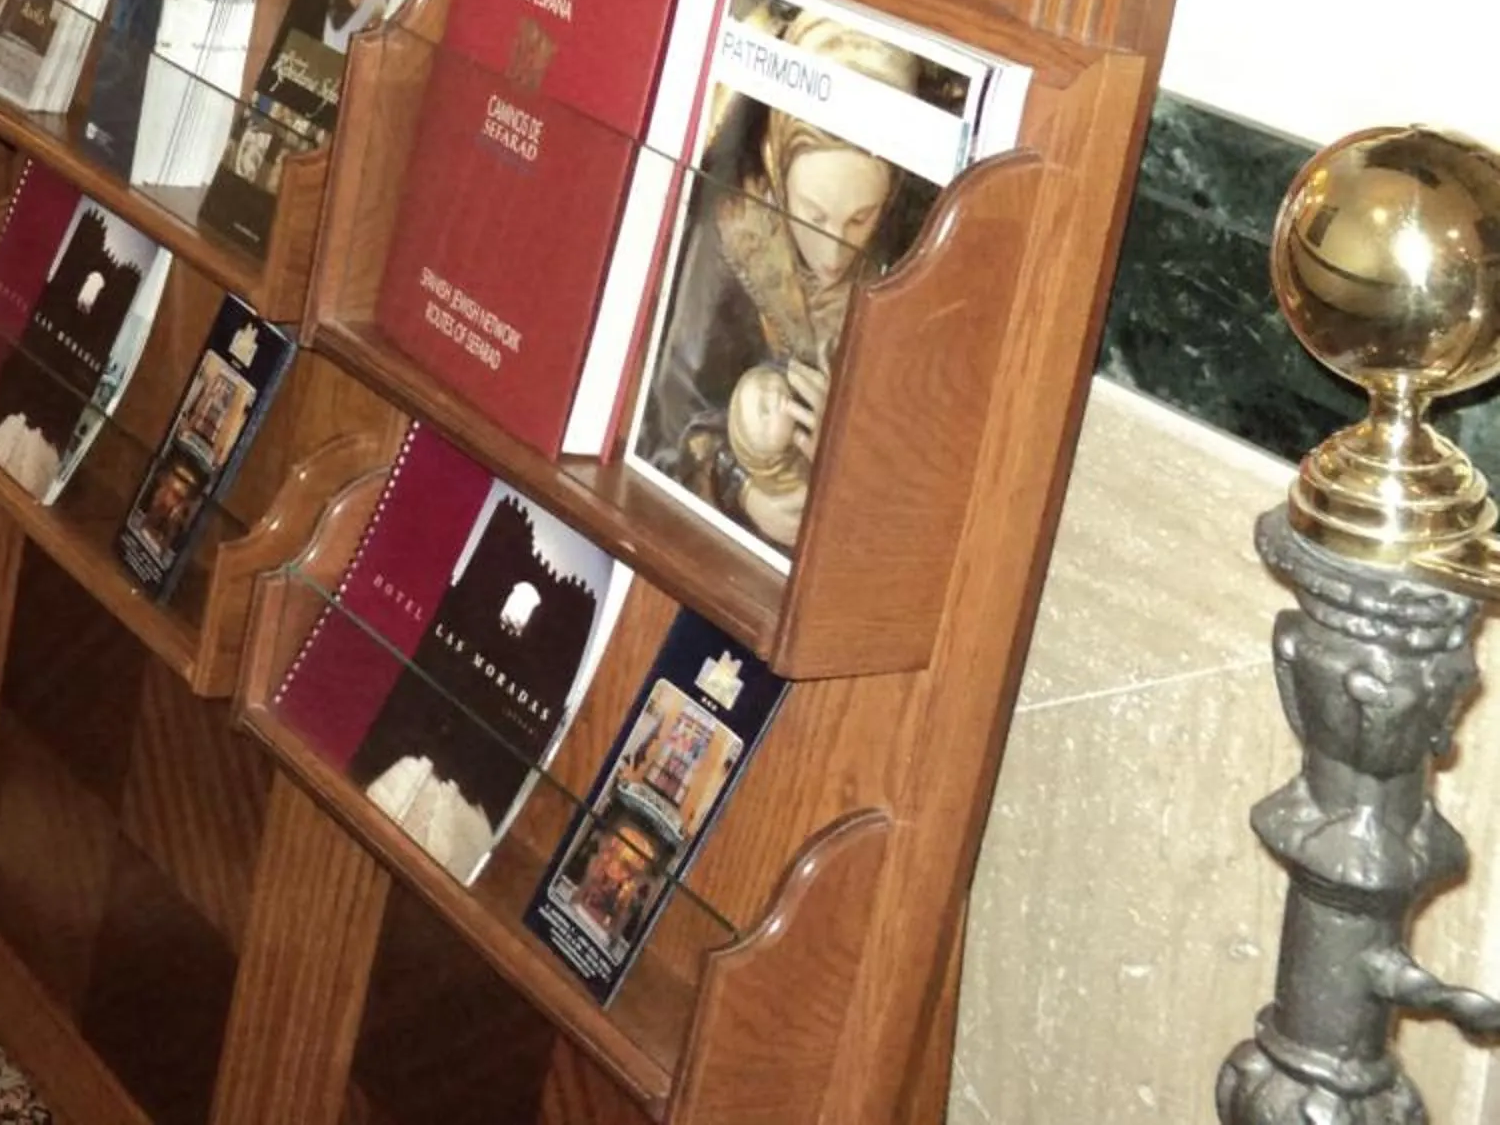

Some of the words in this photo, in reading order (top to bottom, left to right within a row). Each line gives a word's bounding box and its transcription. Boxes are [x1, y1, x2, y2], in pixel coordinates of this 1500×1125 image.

[721, 30, 833, 103] PATRIMONIO
[482, 117, 538, 162] SEFARAD
[372, 573, 424, 622] HOTEL
[434, 622, 466, 653] LAS
[471, 651, 551, 722] MORADAS
